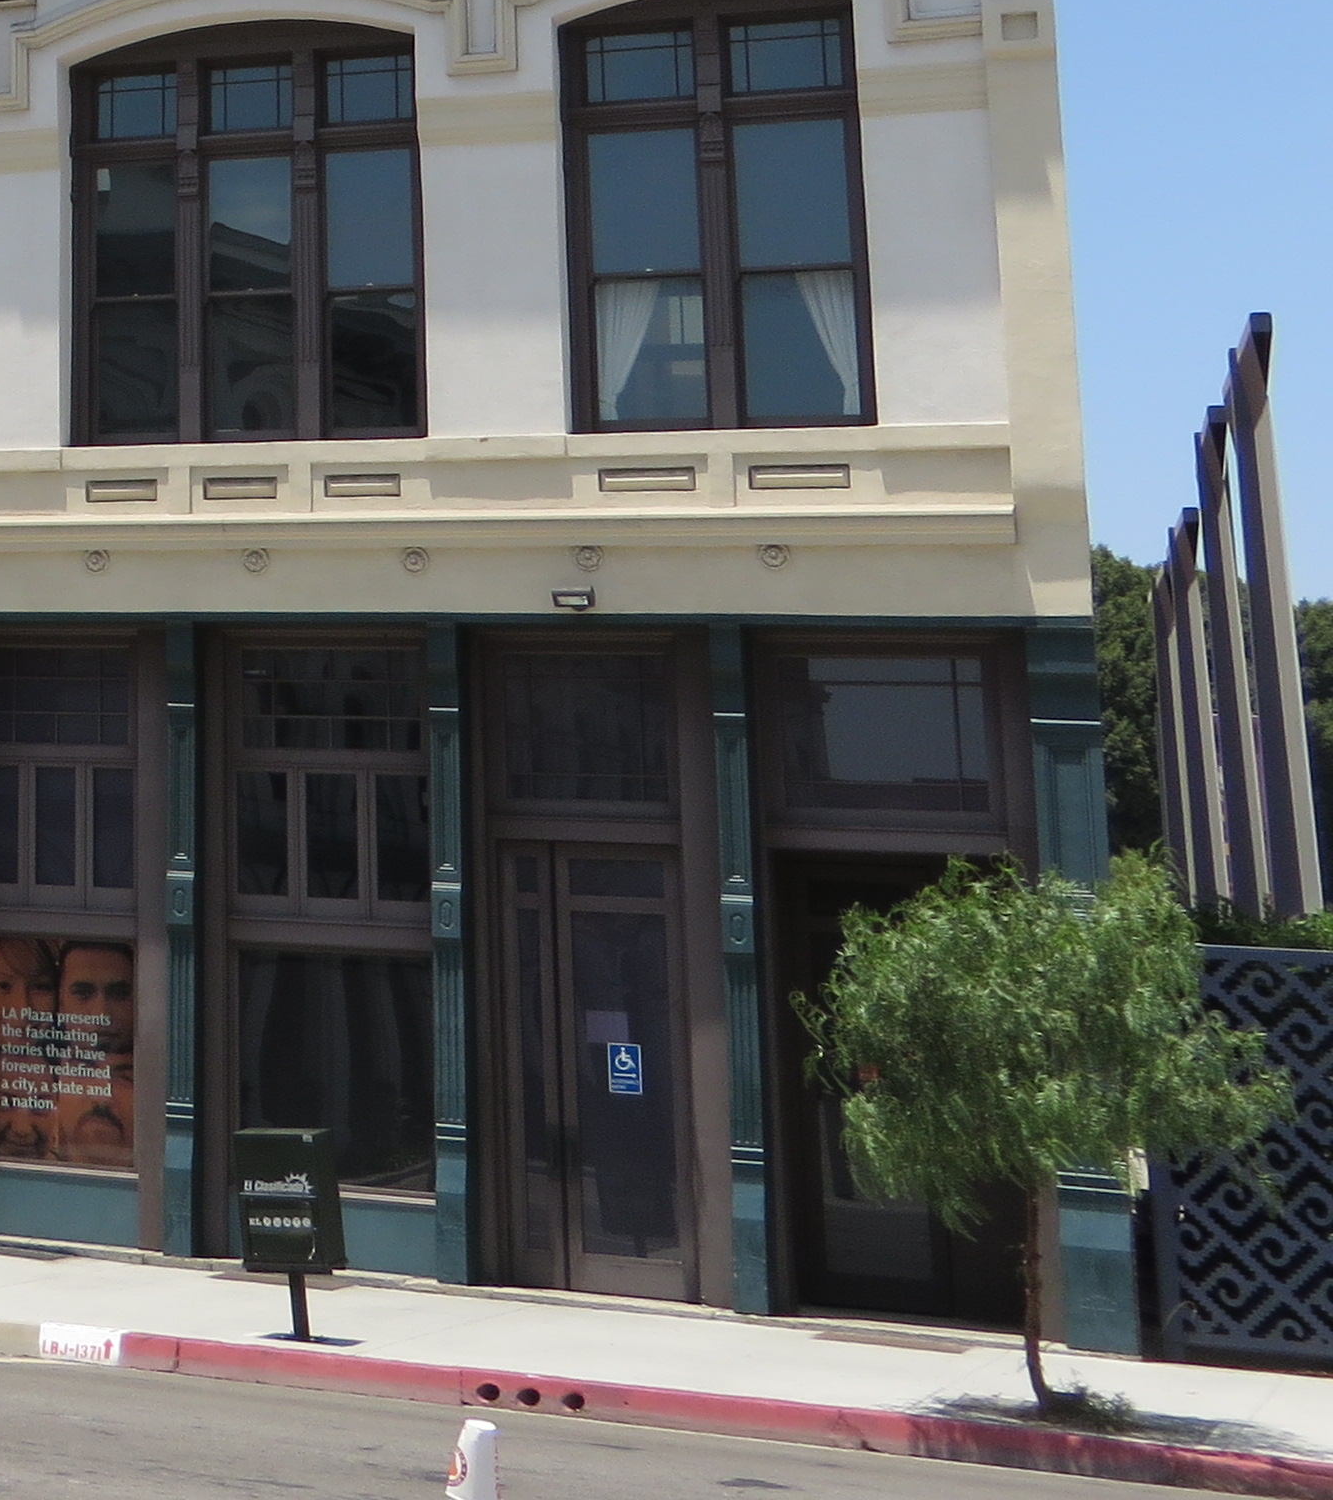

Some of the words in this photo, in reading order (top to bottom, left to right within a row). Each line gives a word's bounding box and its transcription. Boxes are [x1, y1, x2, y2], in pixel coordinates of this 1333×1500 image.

[1, 1006, 18, 1020] LA
[20, 1006, 53, 1022] Plaza
[57, 1012, 111, 1027] presents
[1, 1023, 22, 1037] the
[26, 1025, 98, 1046] fascinating
[1, 1042, 43, 1057] stories
[45, 1043, 72, 1058] that
[75, 1045, 106, 1061] have
[1, 1058, 46, 1074] forever
[49, 1062, 111, 1079] redefined
[1, 1078, 9, 1089] a
[12, 1076, 38, 1095] city,
[40, 1081, 50, 1092] a
[52, 1080, 84, 1095] state
[86, 1082, 112, 1097] and
[0, 1095, 9, 1107] a
[12, 1094, 58, 1111] nation.
[41, 1339, 102, 1361] LBJ-1371
